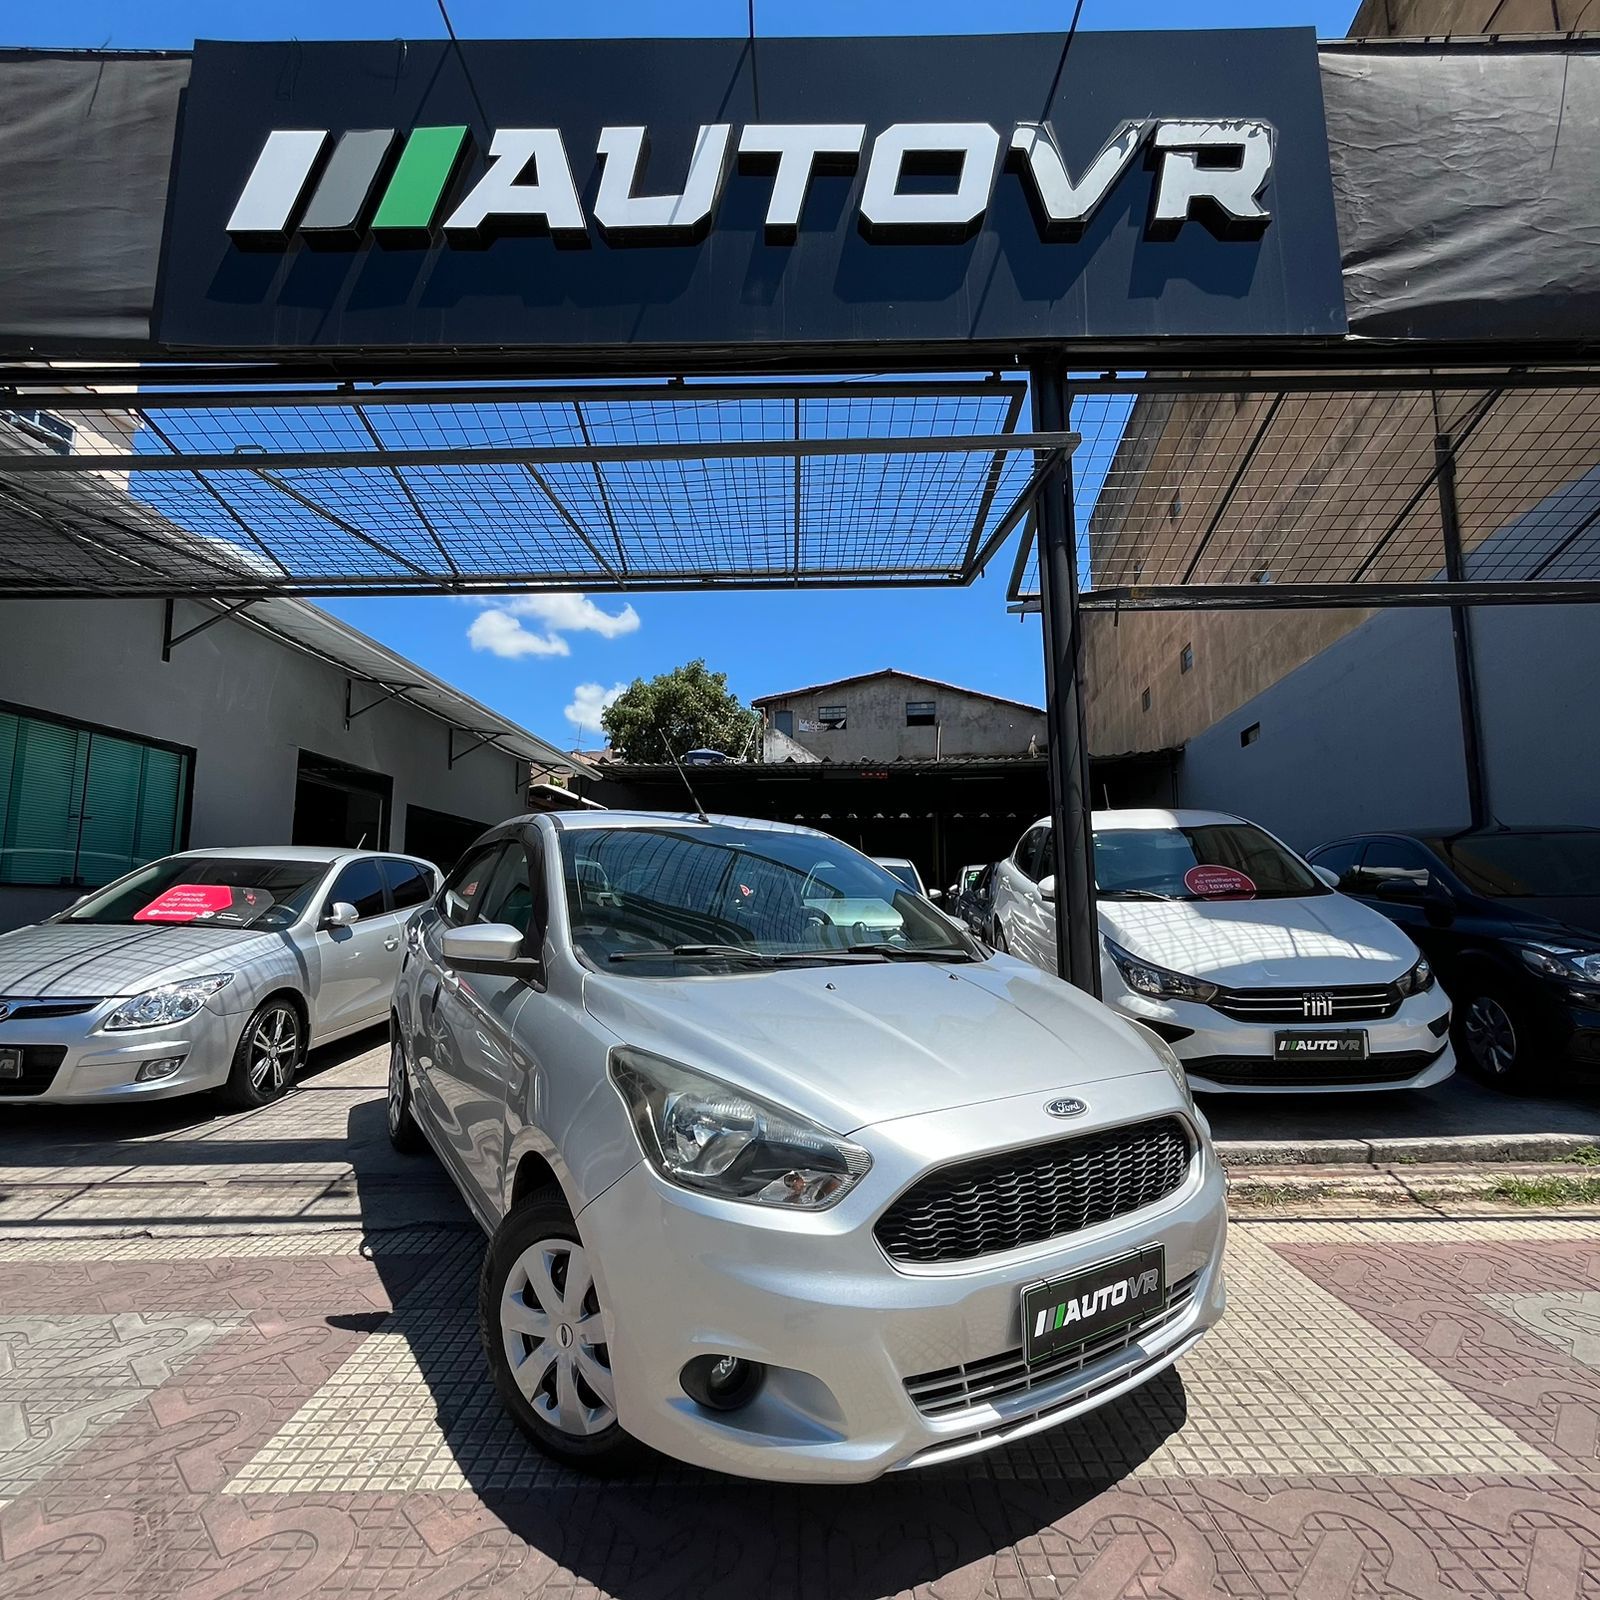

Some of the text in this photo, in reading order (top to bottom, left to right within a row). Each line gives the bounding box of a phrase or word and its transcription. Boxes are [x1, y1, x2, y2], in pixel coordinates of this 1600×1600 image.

[441, 119, 1276, 232] AUTOVR
[1296, 1040, 1360, 1051] AUTOVR
[1056, 1100, 1081, 1113] Ford
[1063, 1268, 1159, 1326] AUTOVR
